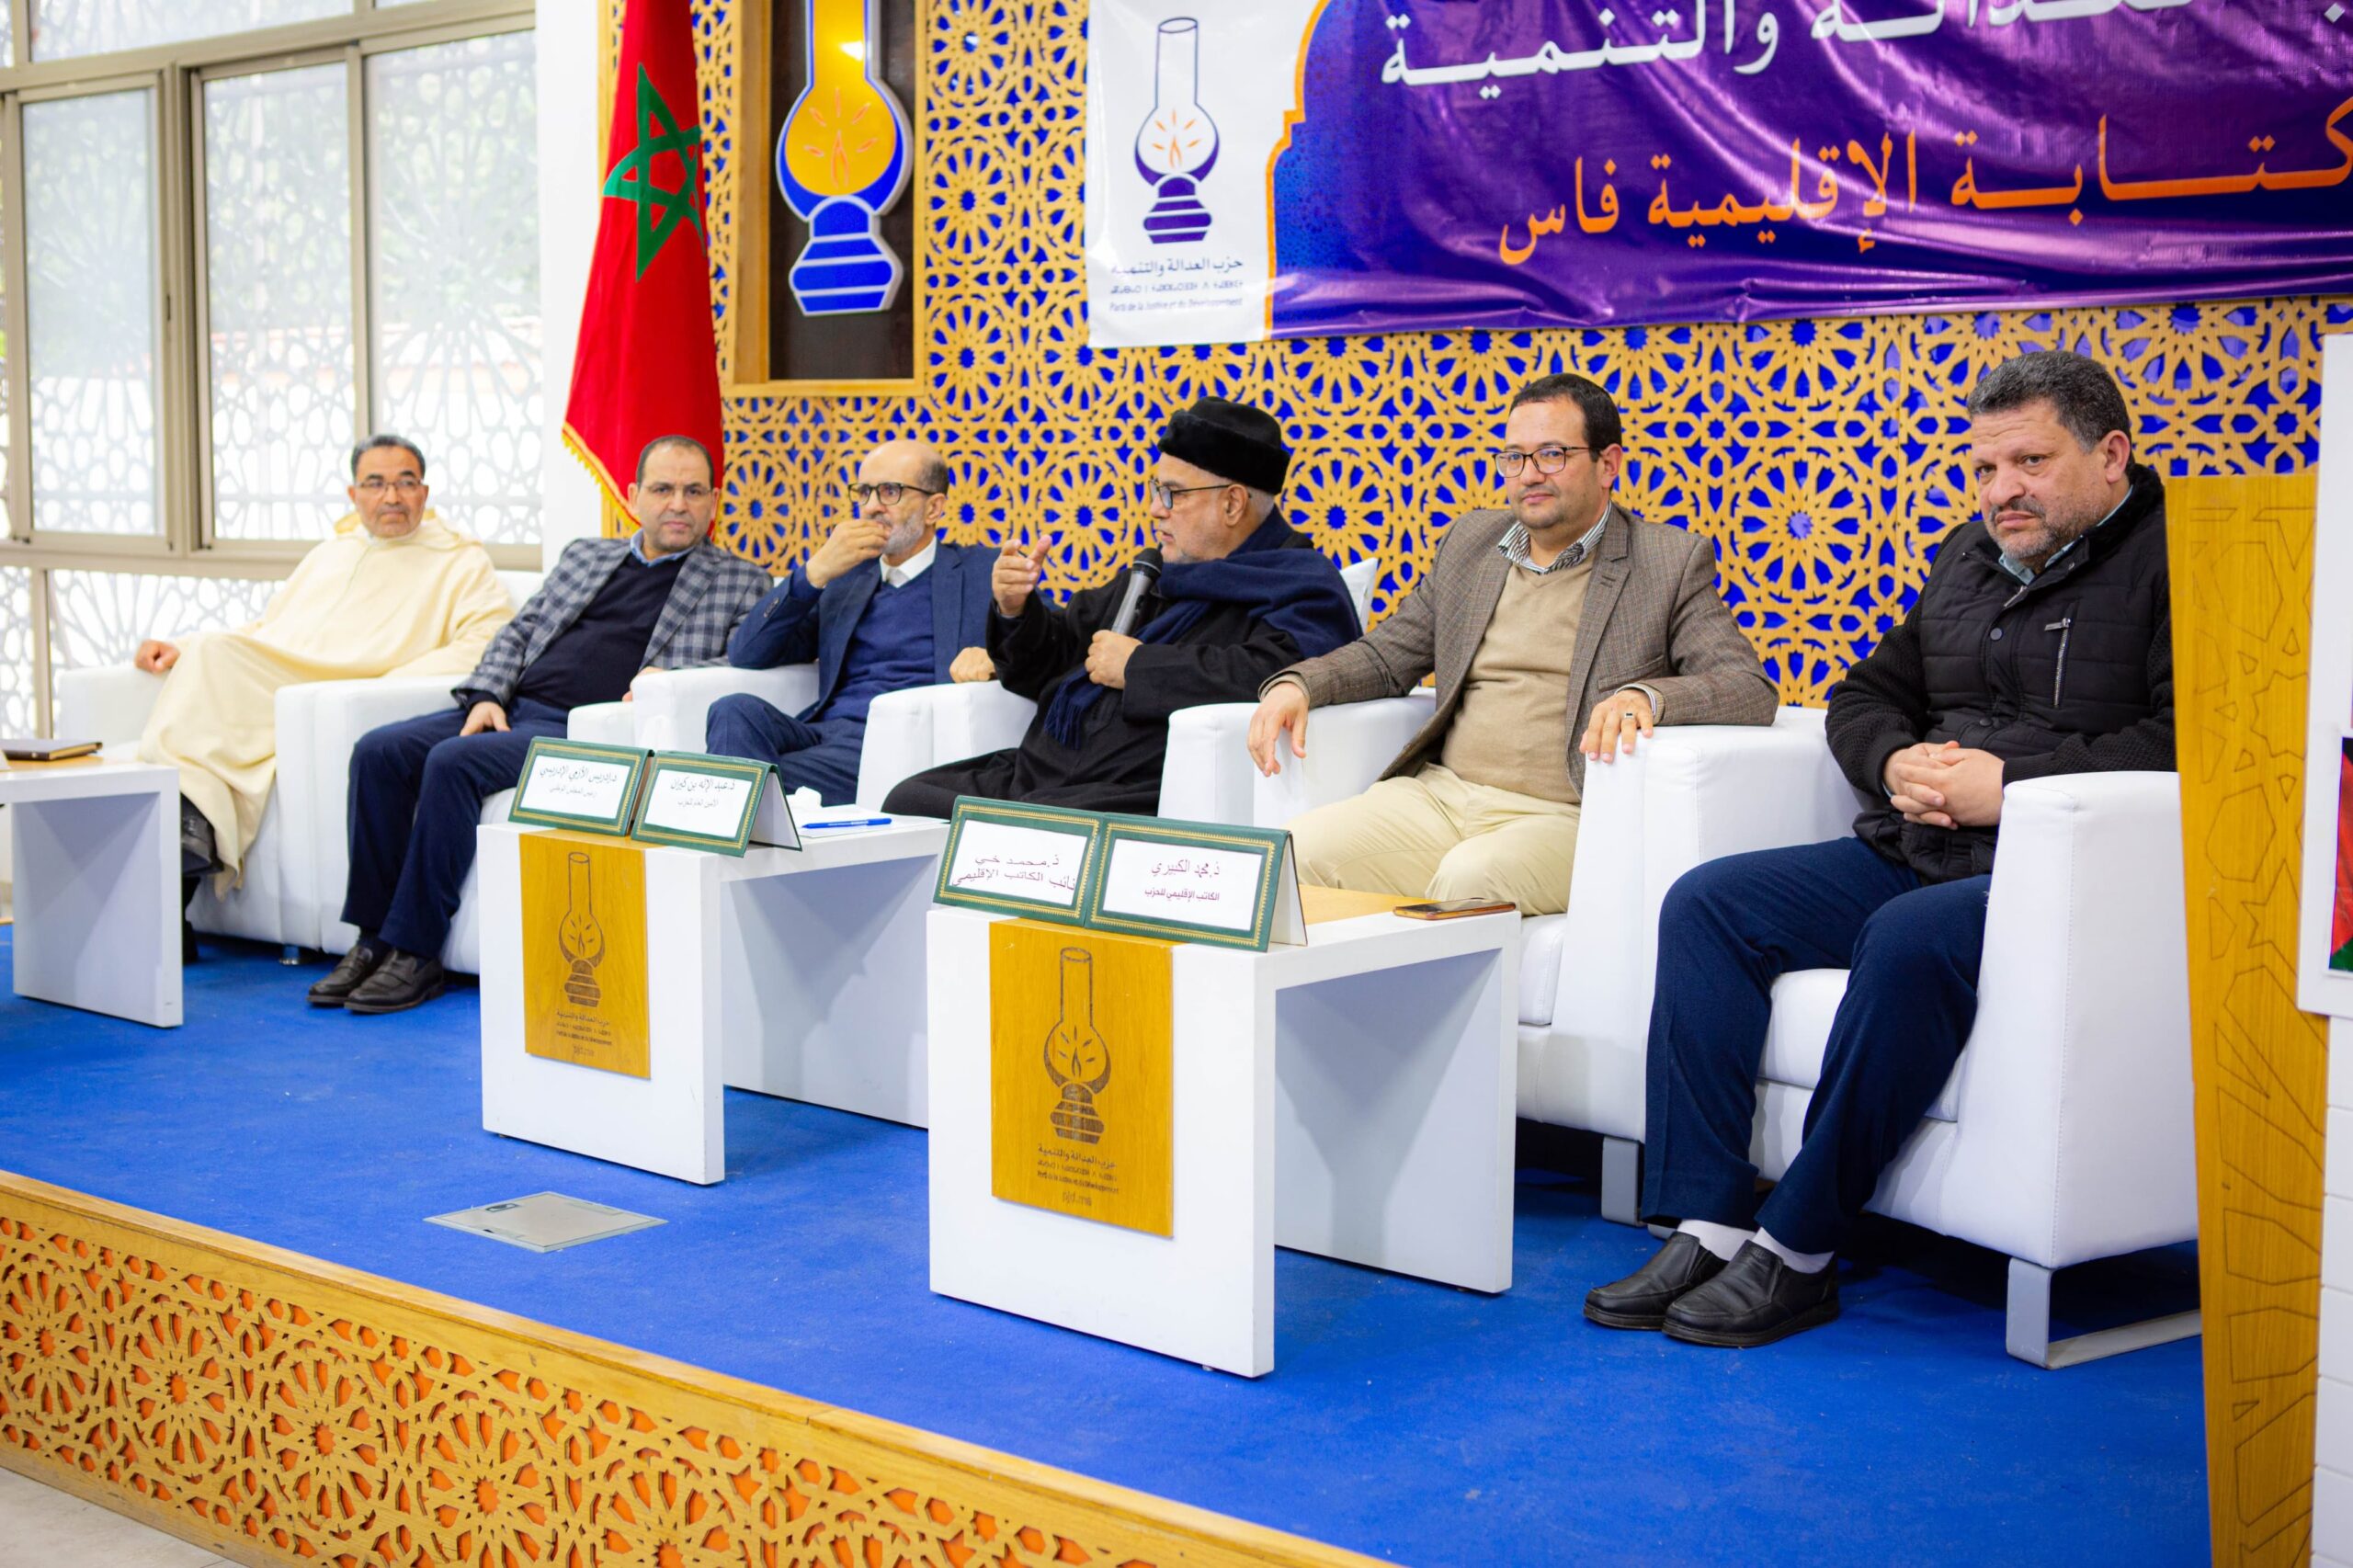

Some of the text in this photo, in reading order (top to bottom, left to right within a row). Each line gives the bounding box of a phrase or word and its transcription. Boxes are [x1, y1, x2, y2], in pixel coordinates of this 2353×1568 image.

[1647, 127, 1917, 254] الإقليمية
[1499, 156, 1620, 265] فاس
[1166, 256, 1211, 272] العدالة
[1213, 256, 1244, 274] حزب
[1151, 858, 1190, 878] الكبيري
[1143, 886, 1221, 903] الكاتب الإقليمي للحزب
